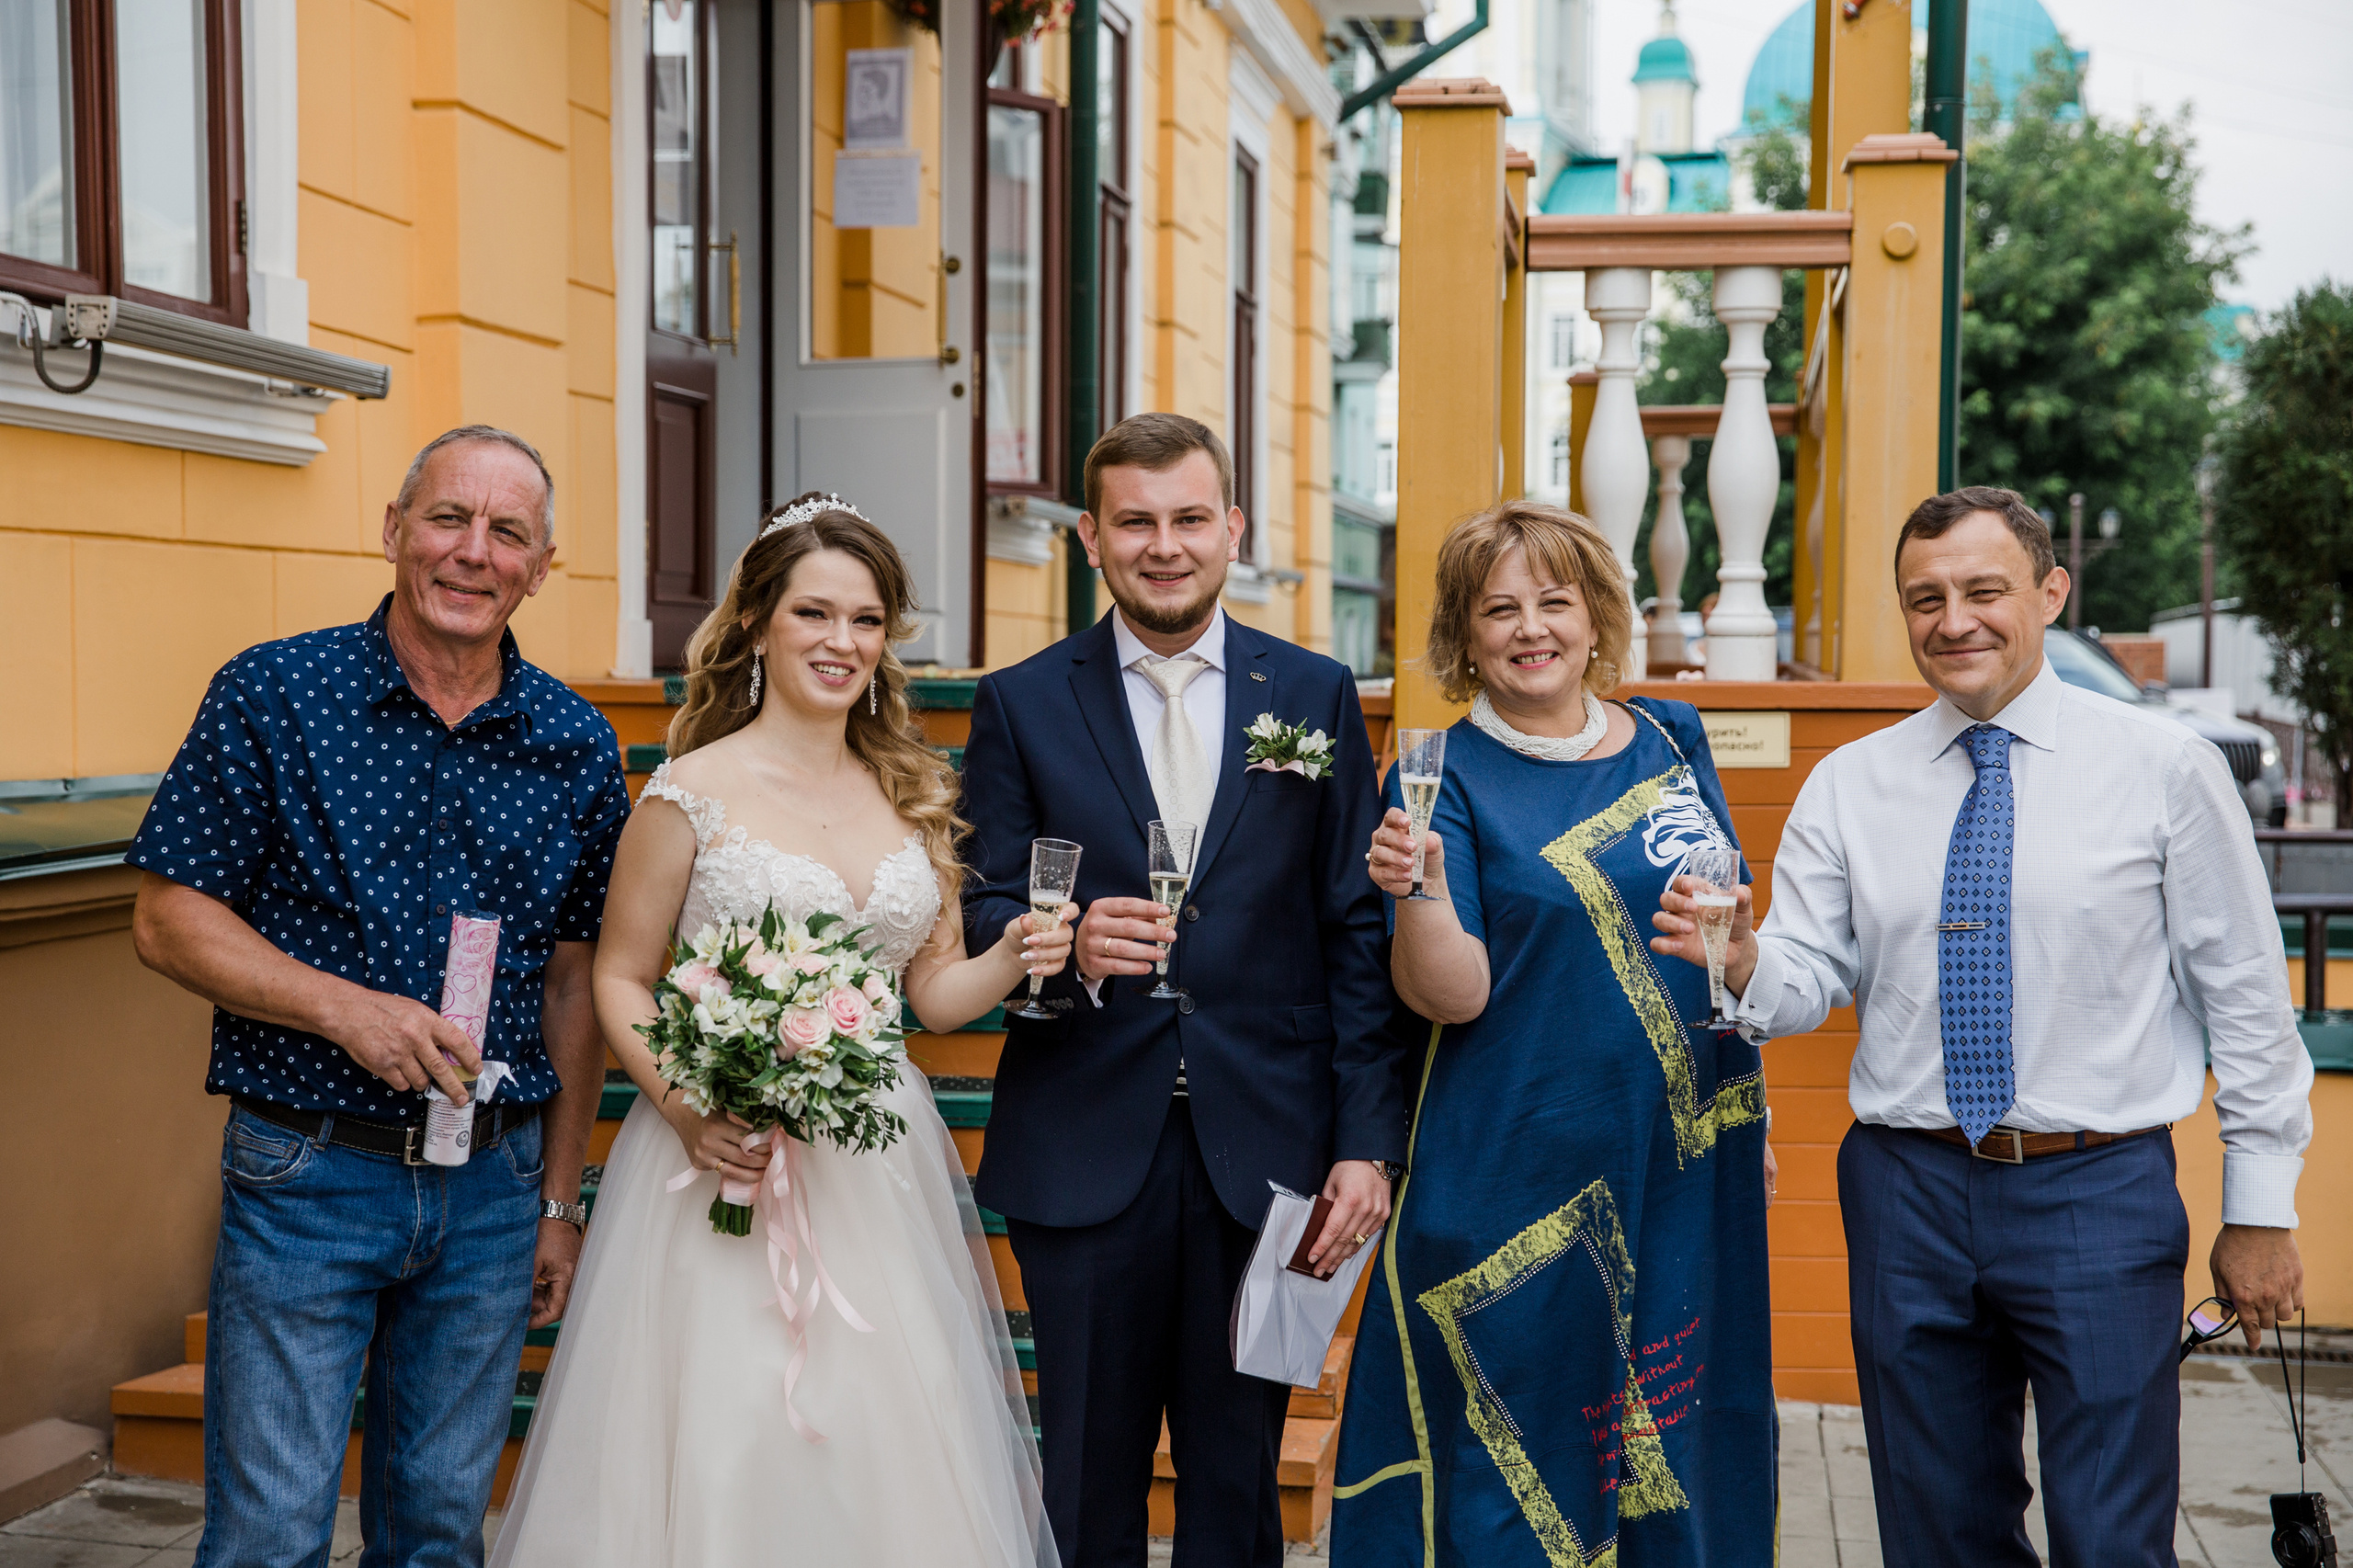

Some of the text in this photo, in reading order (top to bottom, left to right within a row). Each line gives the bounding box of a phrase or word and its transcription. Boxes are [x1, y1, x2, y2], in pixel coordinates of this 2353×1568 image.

[1706, 726, 1748, 739] урить!
[1711, 740, 1765, 752] опасно!
[1642, 1335, 1670, 1356] and
[1674, 1316, 1701, 1346] quiet
[1622, 1404, 1689, 1443] nhabitable
